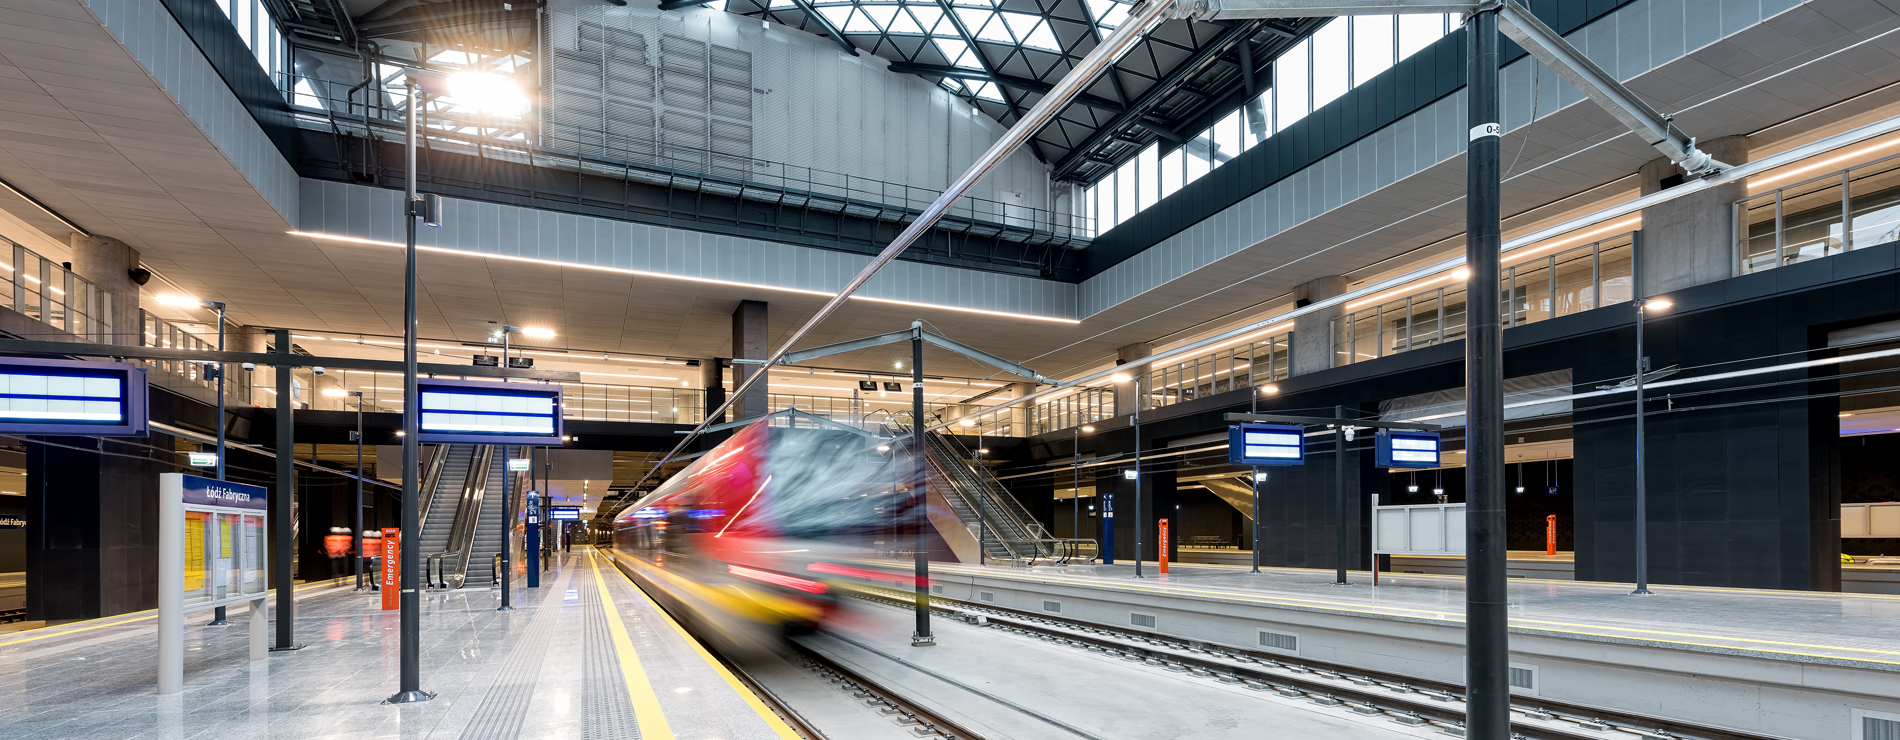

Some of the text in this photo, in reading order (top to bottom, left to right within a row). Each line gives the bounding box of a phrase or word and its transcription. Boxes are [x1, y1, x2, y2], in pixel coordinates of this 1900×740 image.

[206, 486, 250, 503] Łódź Fabryczna
[386, 540, 395, 585] Emergency
